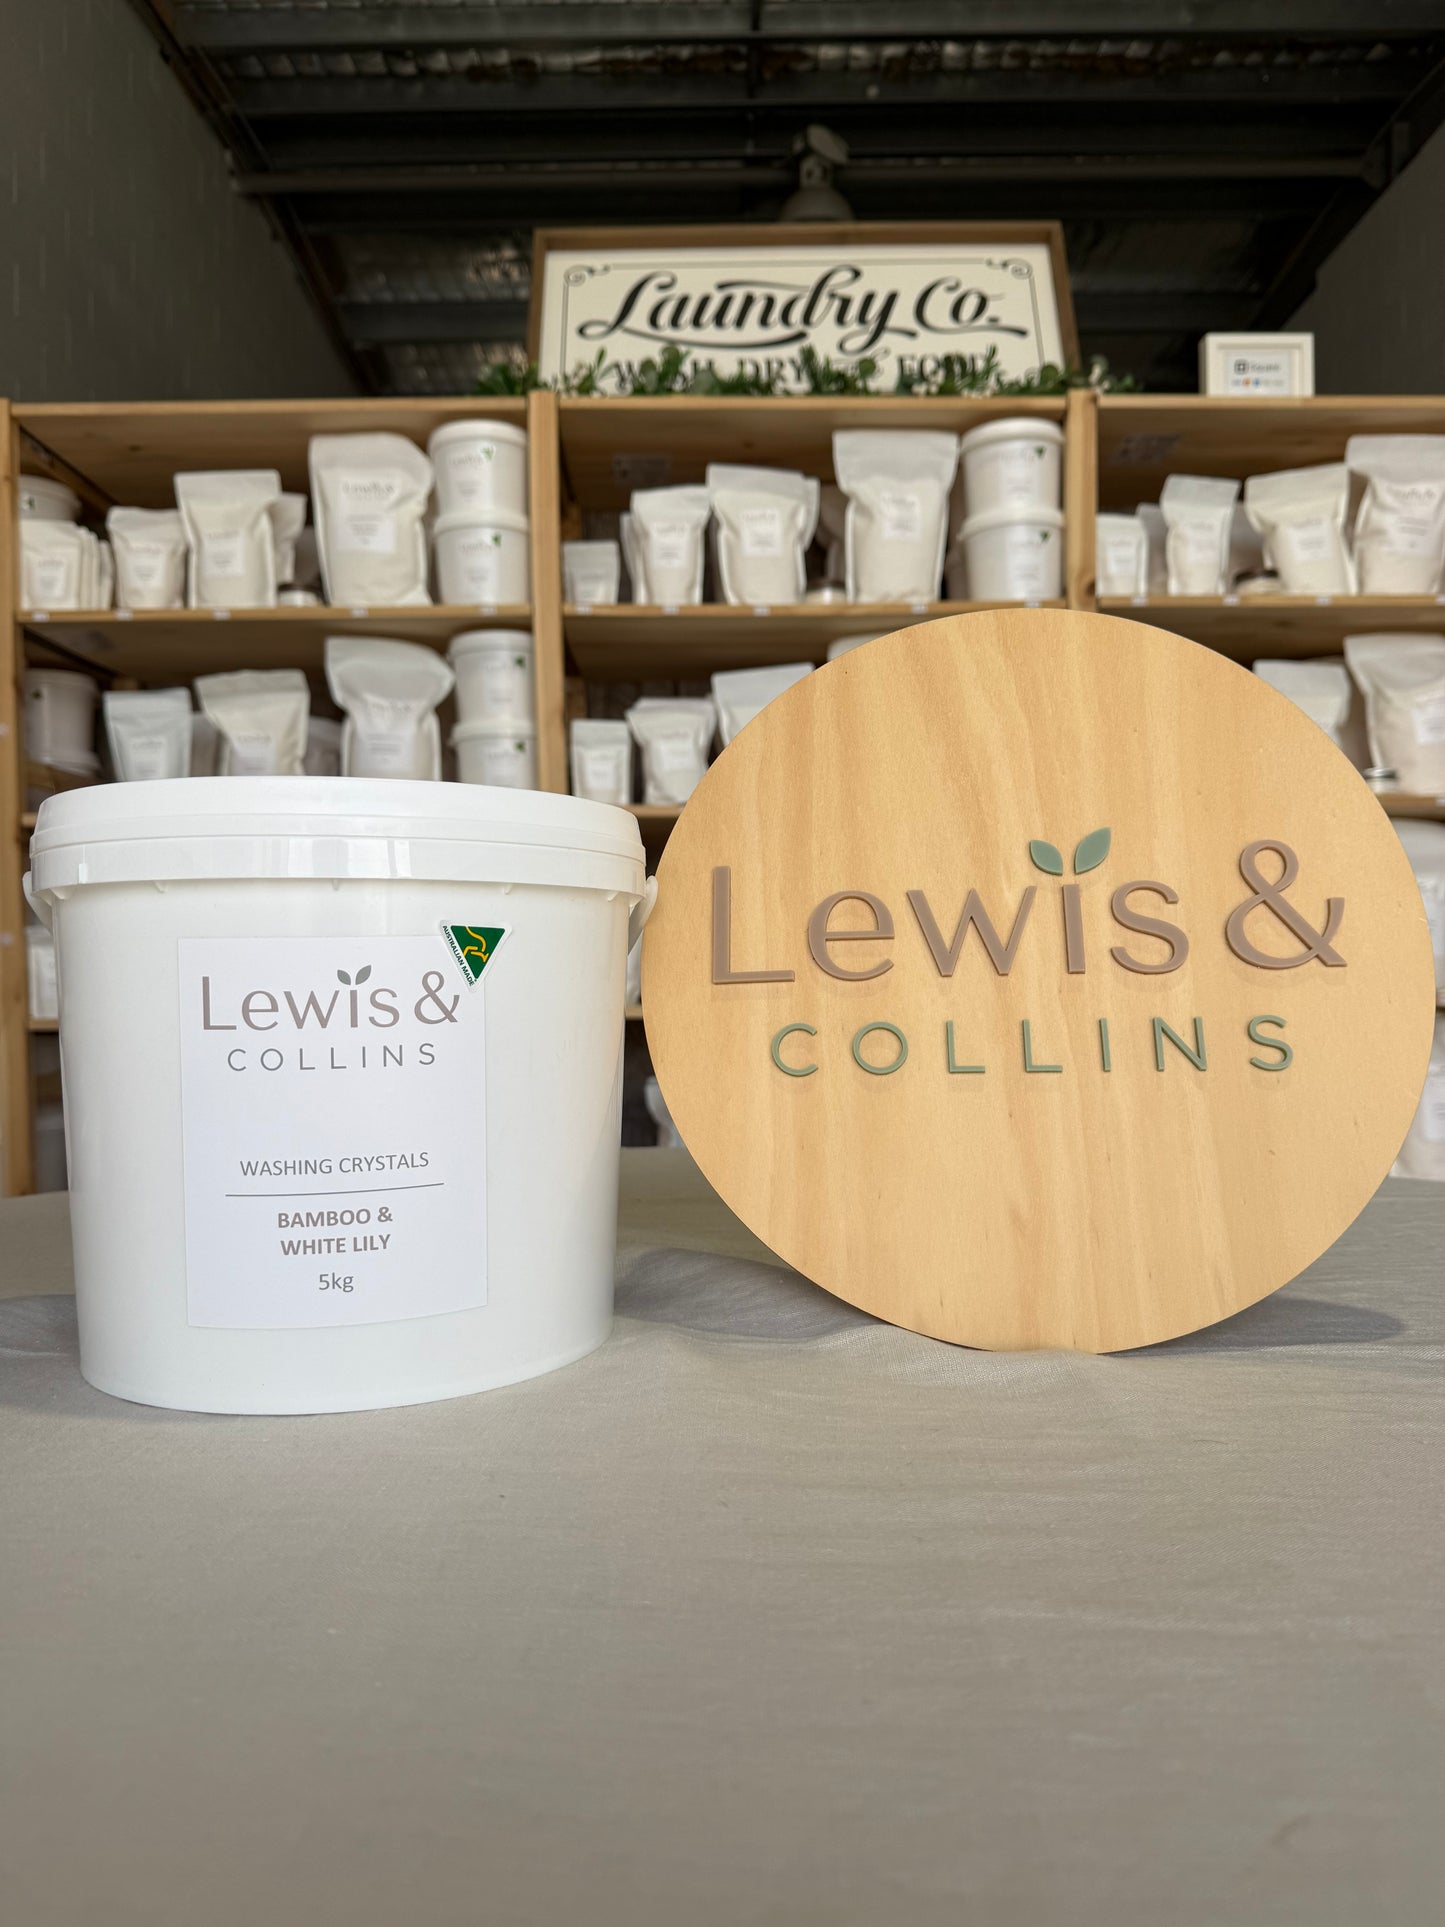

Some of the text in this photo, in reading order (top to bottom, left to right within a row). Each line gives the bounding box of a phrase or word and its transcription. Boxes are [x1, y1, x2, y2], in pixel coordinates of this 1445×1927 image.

[578, 265, 1028, 356] Laundry Co.
[712, 827, 1348, 985] Lewis &
[443, 925, 475, 987] AUSTRALIAN MADE
[202, 965, 461, 1031] Lewis &
[227, 1042, 436, 1072] COLLINS
[772, 1015, 1294, 1077] COLLINS
[239, 1151, 430, 1177] WASHING CRYSTALS
[277, 1206, 394, 1229] BAMBOO &
[279, 1233, 391, 1256] WHITE LILY
[318, 1272, 355, 1293] 5kg
